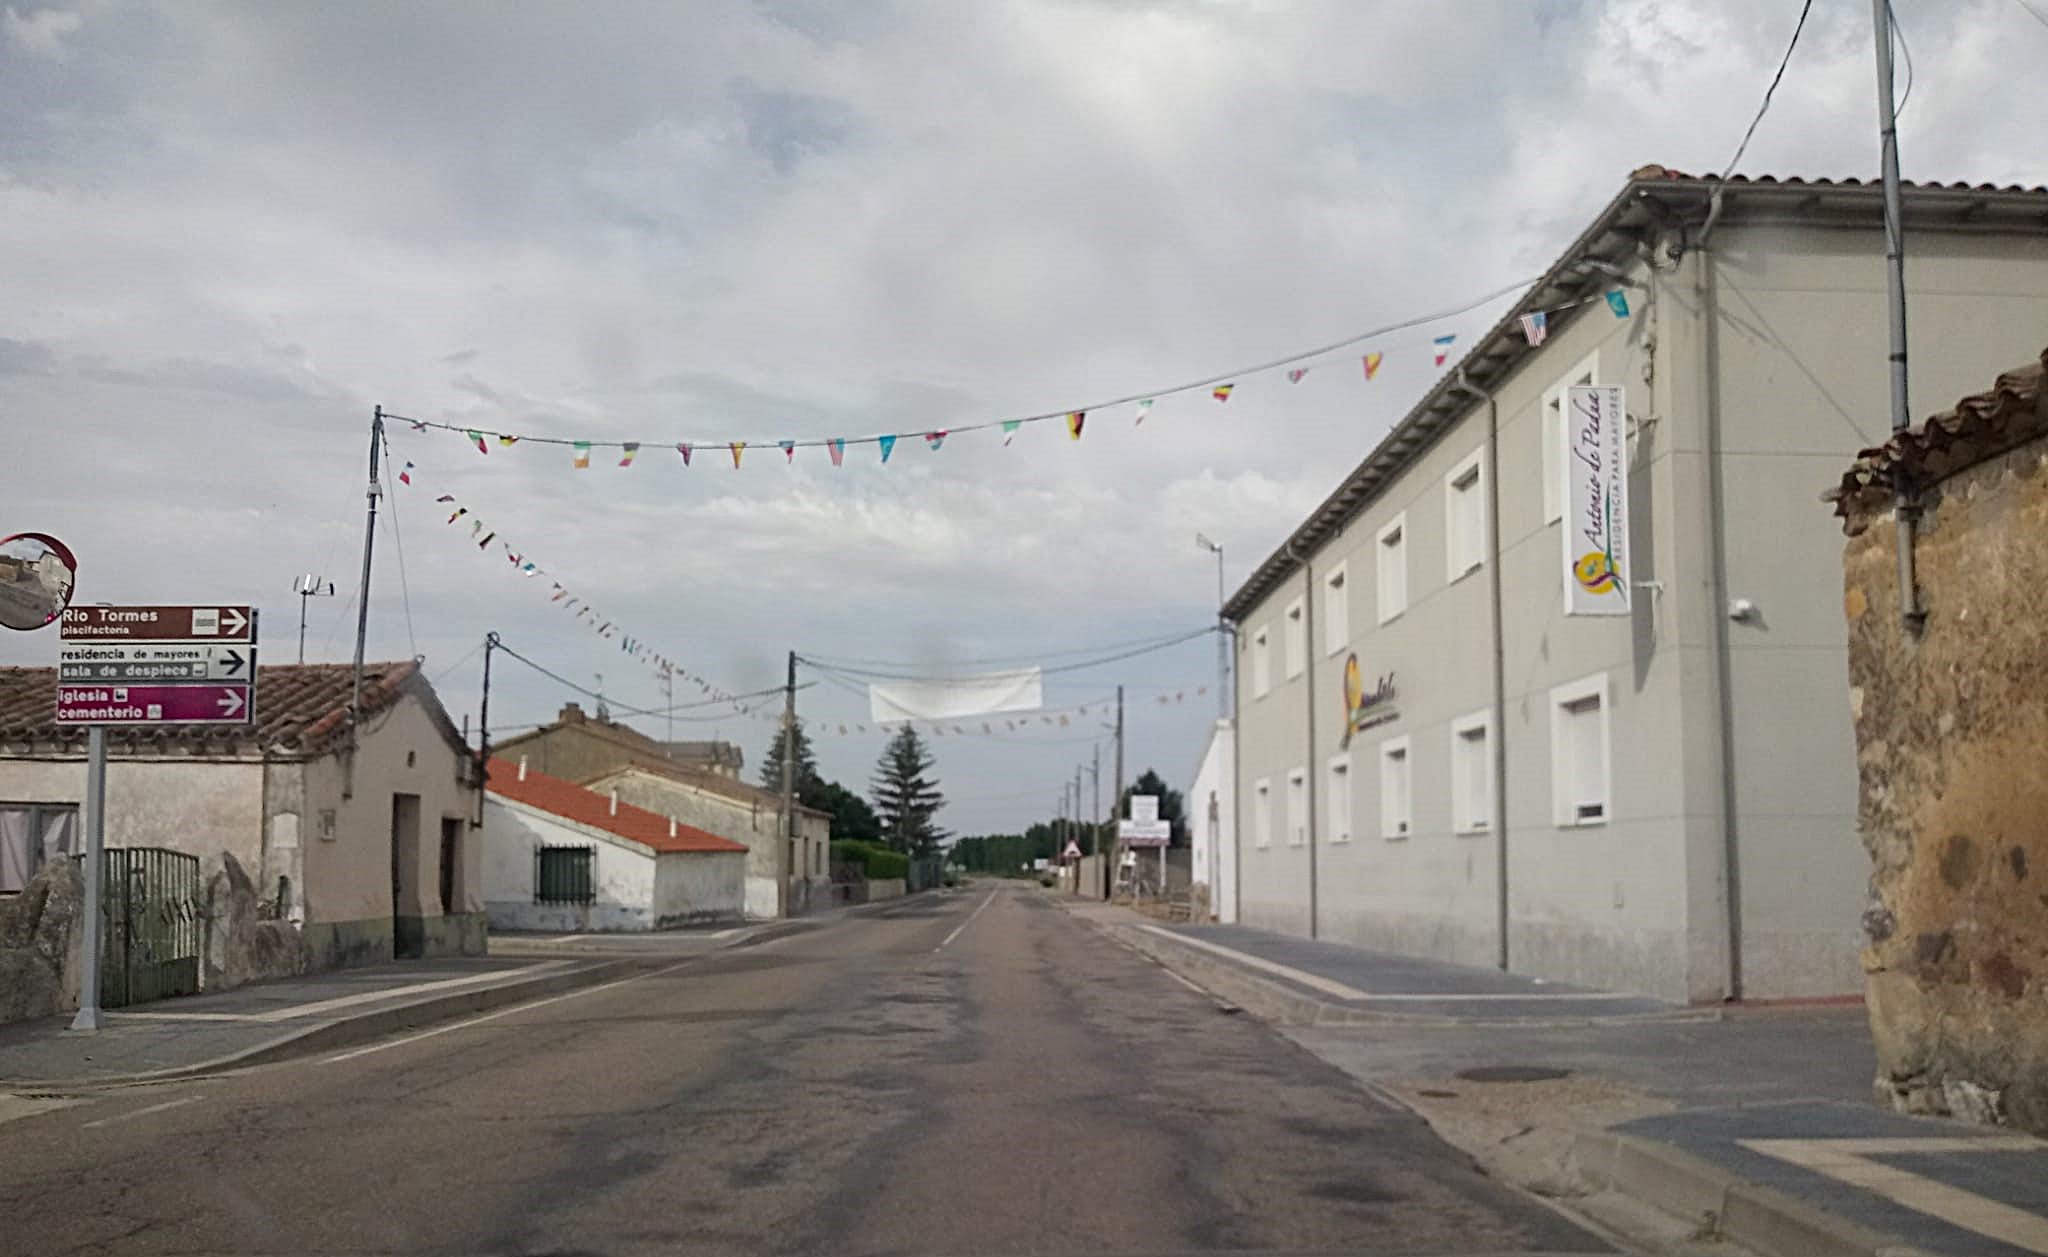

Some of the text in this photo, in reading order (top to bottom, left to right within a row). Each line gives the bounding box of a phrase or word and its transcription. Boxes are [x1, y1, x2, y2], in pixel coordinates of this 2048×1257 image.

[1572, 391, 1604, 552] Antonio de Padua
[1610, 451, 1621, 480] PARA
[1611, 485, 1624, 561] RESIDENCIA
[100, 610, 158, 622] Tormes
[61, 649, 124, 660] residencia
[134, 649, 147, 659] de
[154, 650, 200, 661] mayores
[63, 665, 188, 678] sala de despiece
[59, 690, 108, 704] iglesia
[58, 707, 143, 719] cementerio
